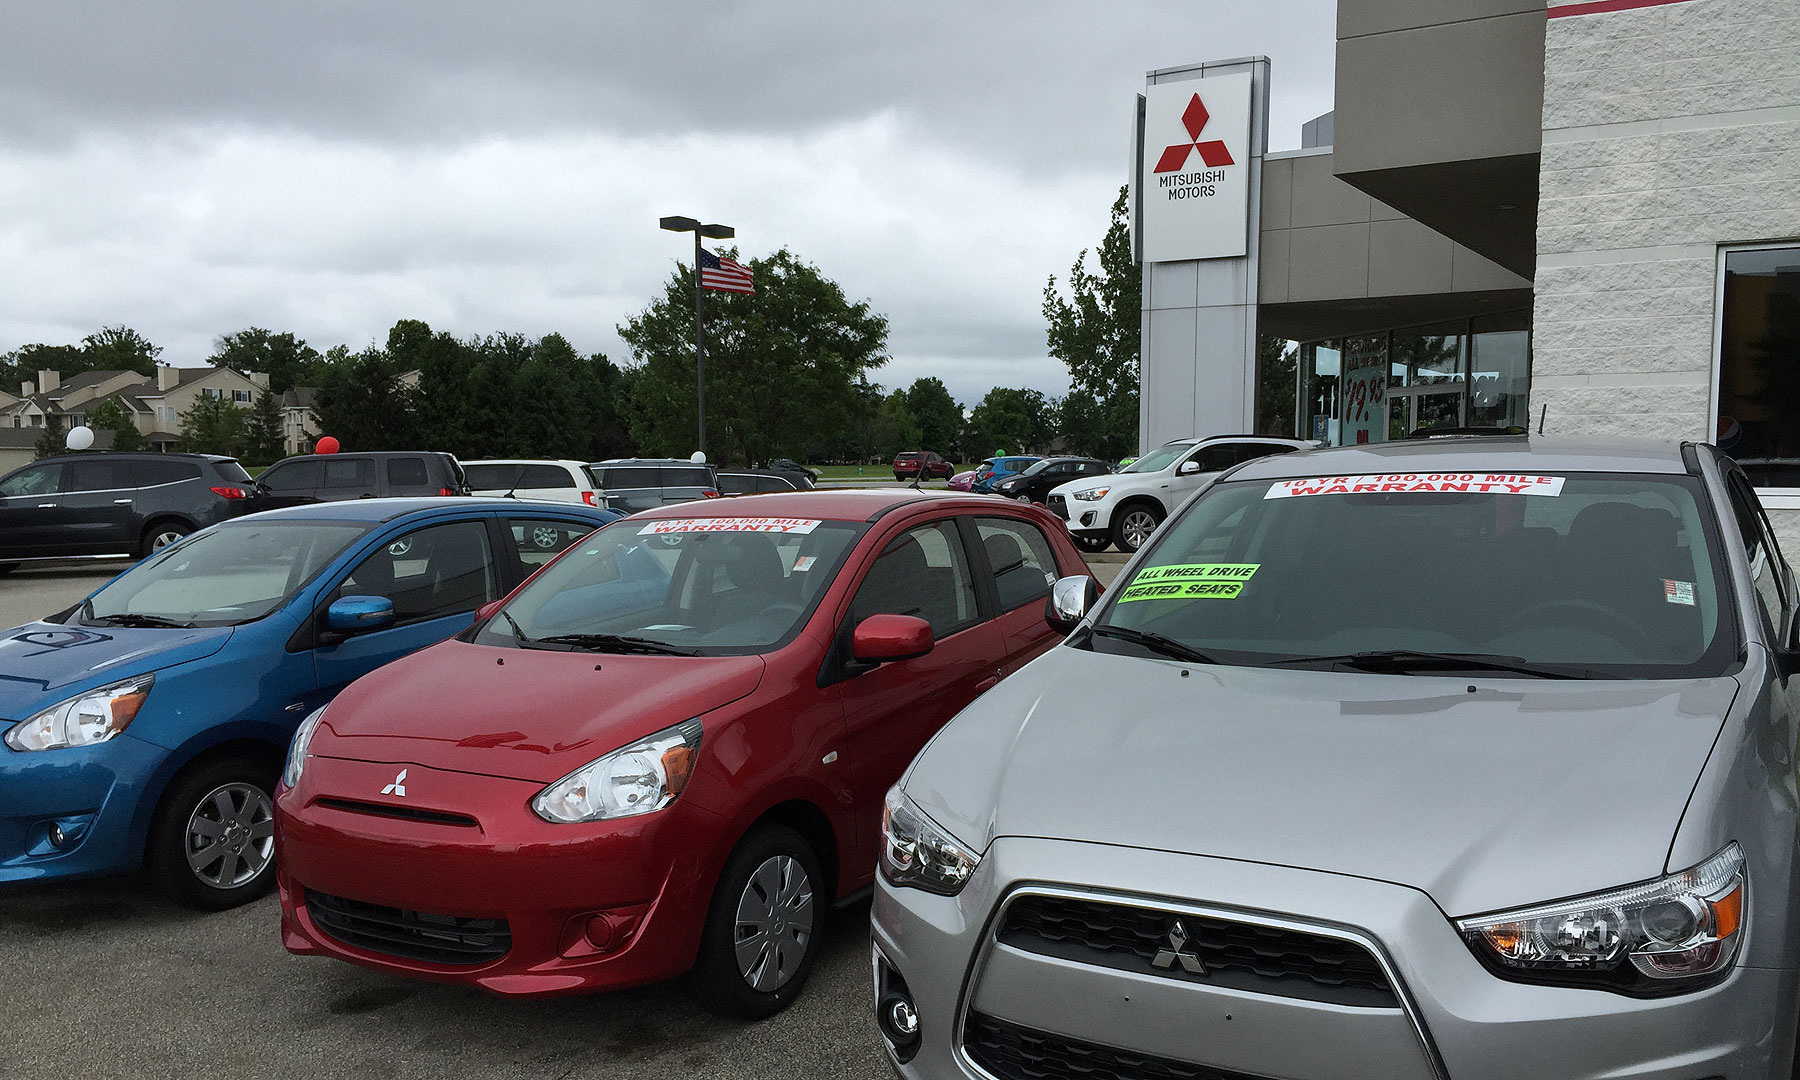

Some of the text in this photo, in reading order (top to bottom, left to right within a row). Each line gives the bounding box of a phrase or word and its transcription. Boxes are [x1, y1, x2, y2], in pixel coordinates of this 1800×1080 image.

[1160, 170, 1225, 187] MITSUBISHI
[1169, 185, 1215, 200] MOTORS
[1283, 480, 1308, 488] 10
[1319, 477, 1349, 485] YR
[1374, 474, 1474, 483] 100,000
[1485, 475, 1553, 485] MILE
[1292, 483, 1531, 495] WARRANTY
[655, 525, 797, 533] WARRANTY
[773, 518, 814, 526] MILE
[1137, 567, 1256, 581] ALL WHEEL DRIVE
[1122, 584, 1241, 599] HEATED SEATS
